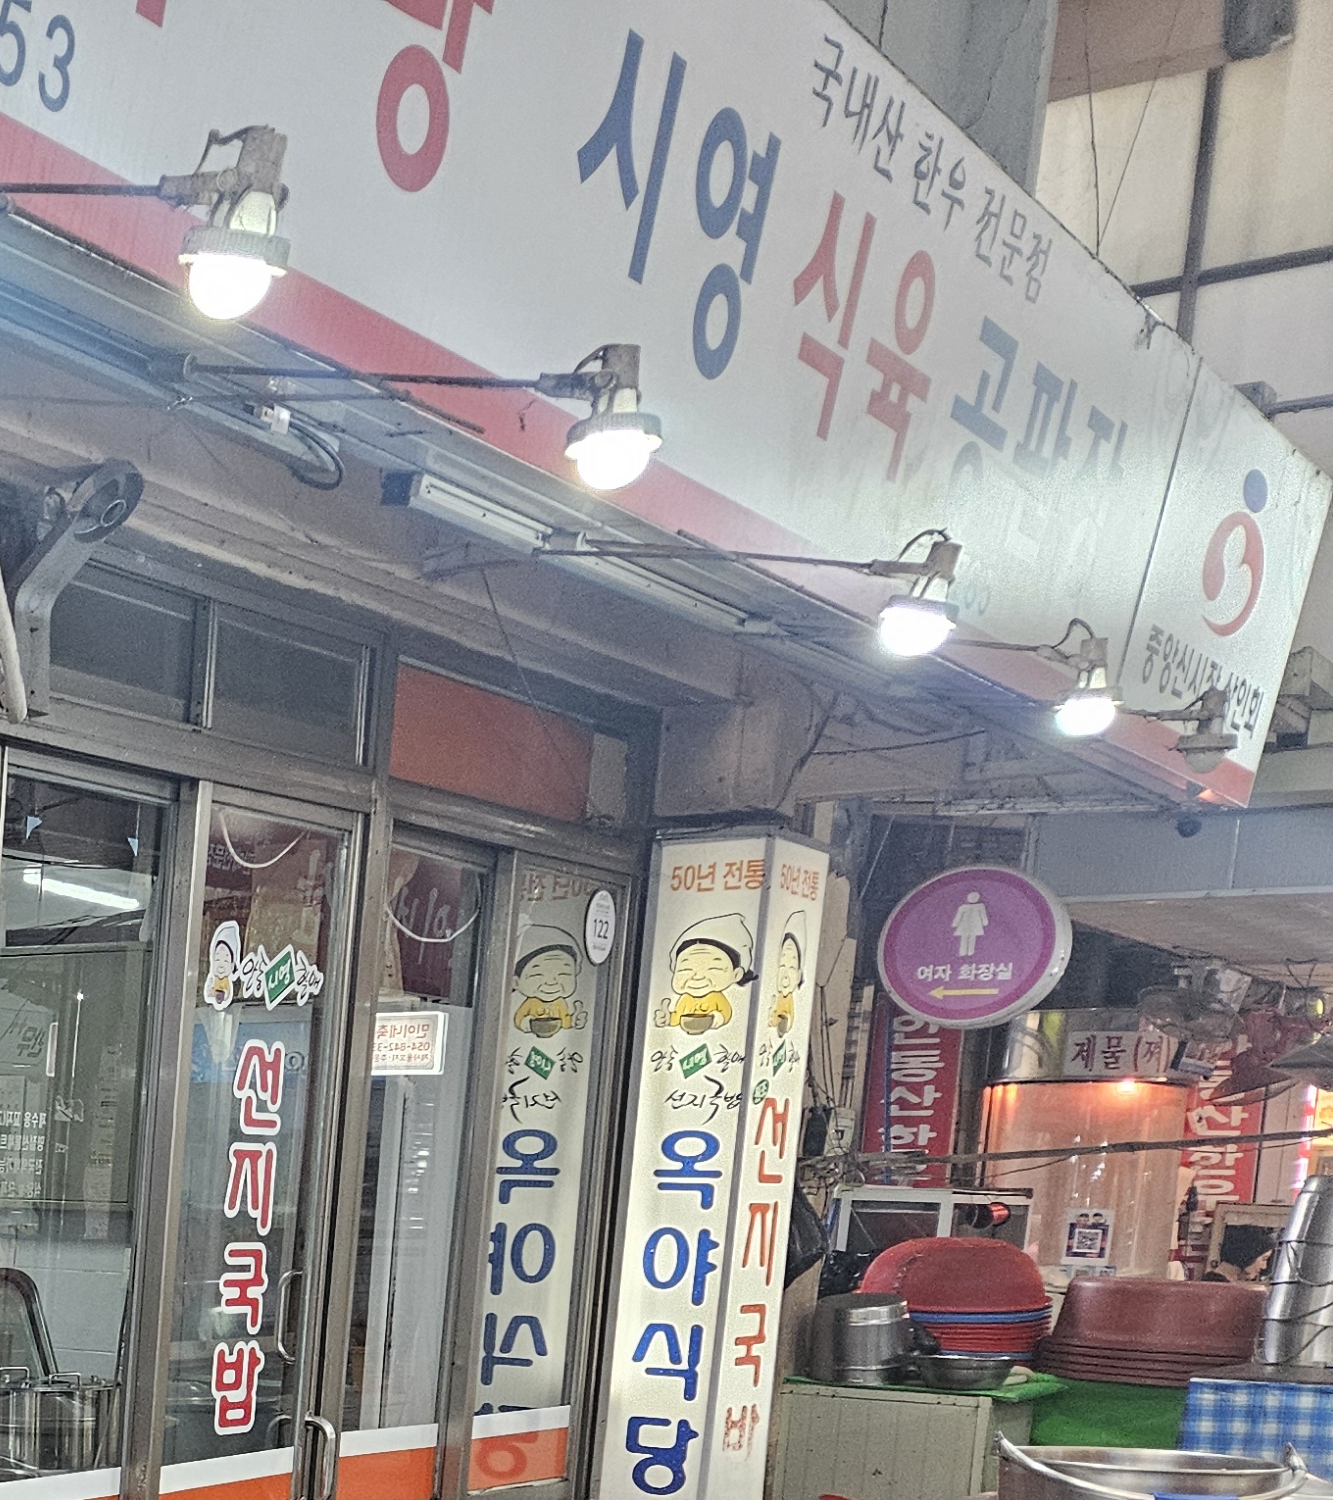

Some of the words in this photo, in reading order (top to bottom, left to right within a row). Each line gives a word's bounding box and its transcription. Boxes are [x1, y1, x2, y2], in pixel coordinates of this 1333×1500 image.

[812, 33, 905, 183] 국내산
[913, 130, 966, 231] 한우
[975, 186, 1053, 304] 전문점
[670, 861, 717, 892] 50년
[723, 858, 766, 890] 전통
[780, 862, 801, 895] 50년
[802, 869, 820, 901] 전통
[593, 917, 610, 940] 122
[917, 965, 952, 982] 여자
[957, 962, 1013, 982] 화장실
[217, 1044, 281, 1429] 선지국밥
[626, 1130, 722, 1495] 옥야식당
